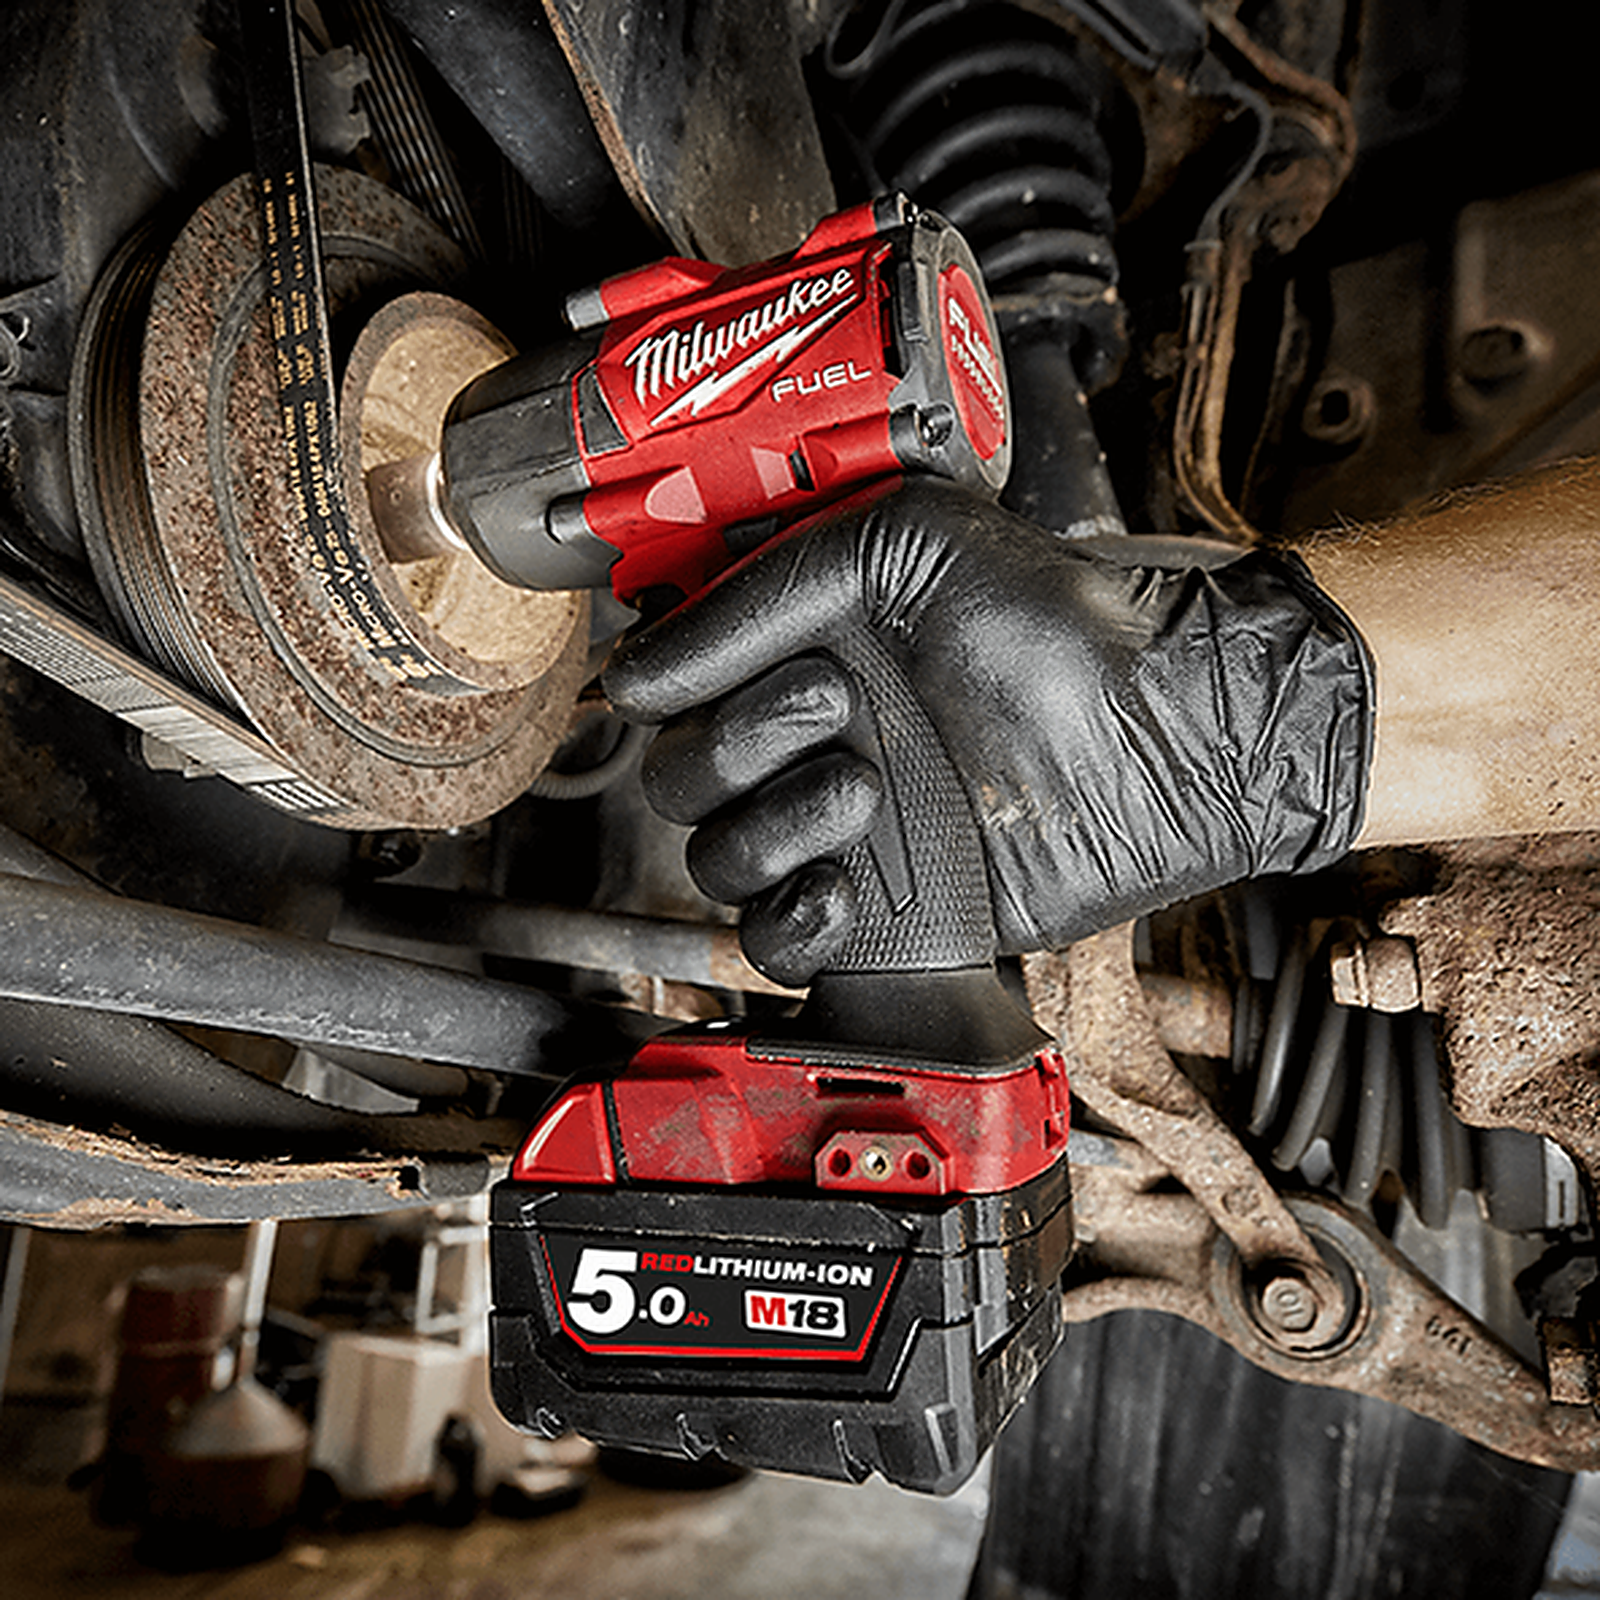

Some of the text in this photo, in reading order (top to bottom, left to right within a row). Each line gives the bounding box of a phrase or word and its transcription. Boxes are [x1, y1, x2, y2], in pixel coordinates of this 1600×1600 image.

[625, 267, 855, 404] Milwaukee
[771, 360, 872, 403] FUEL
[750, 1294, 839, 1330] M18
